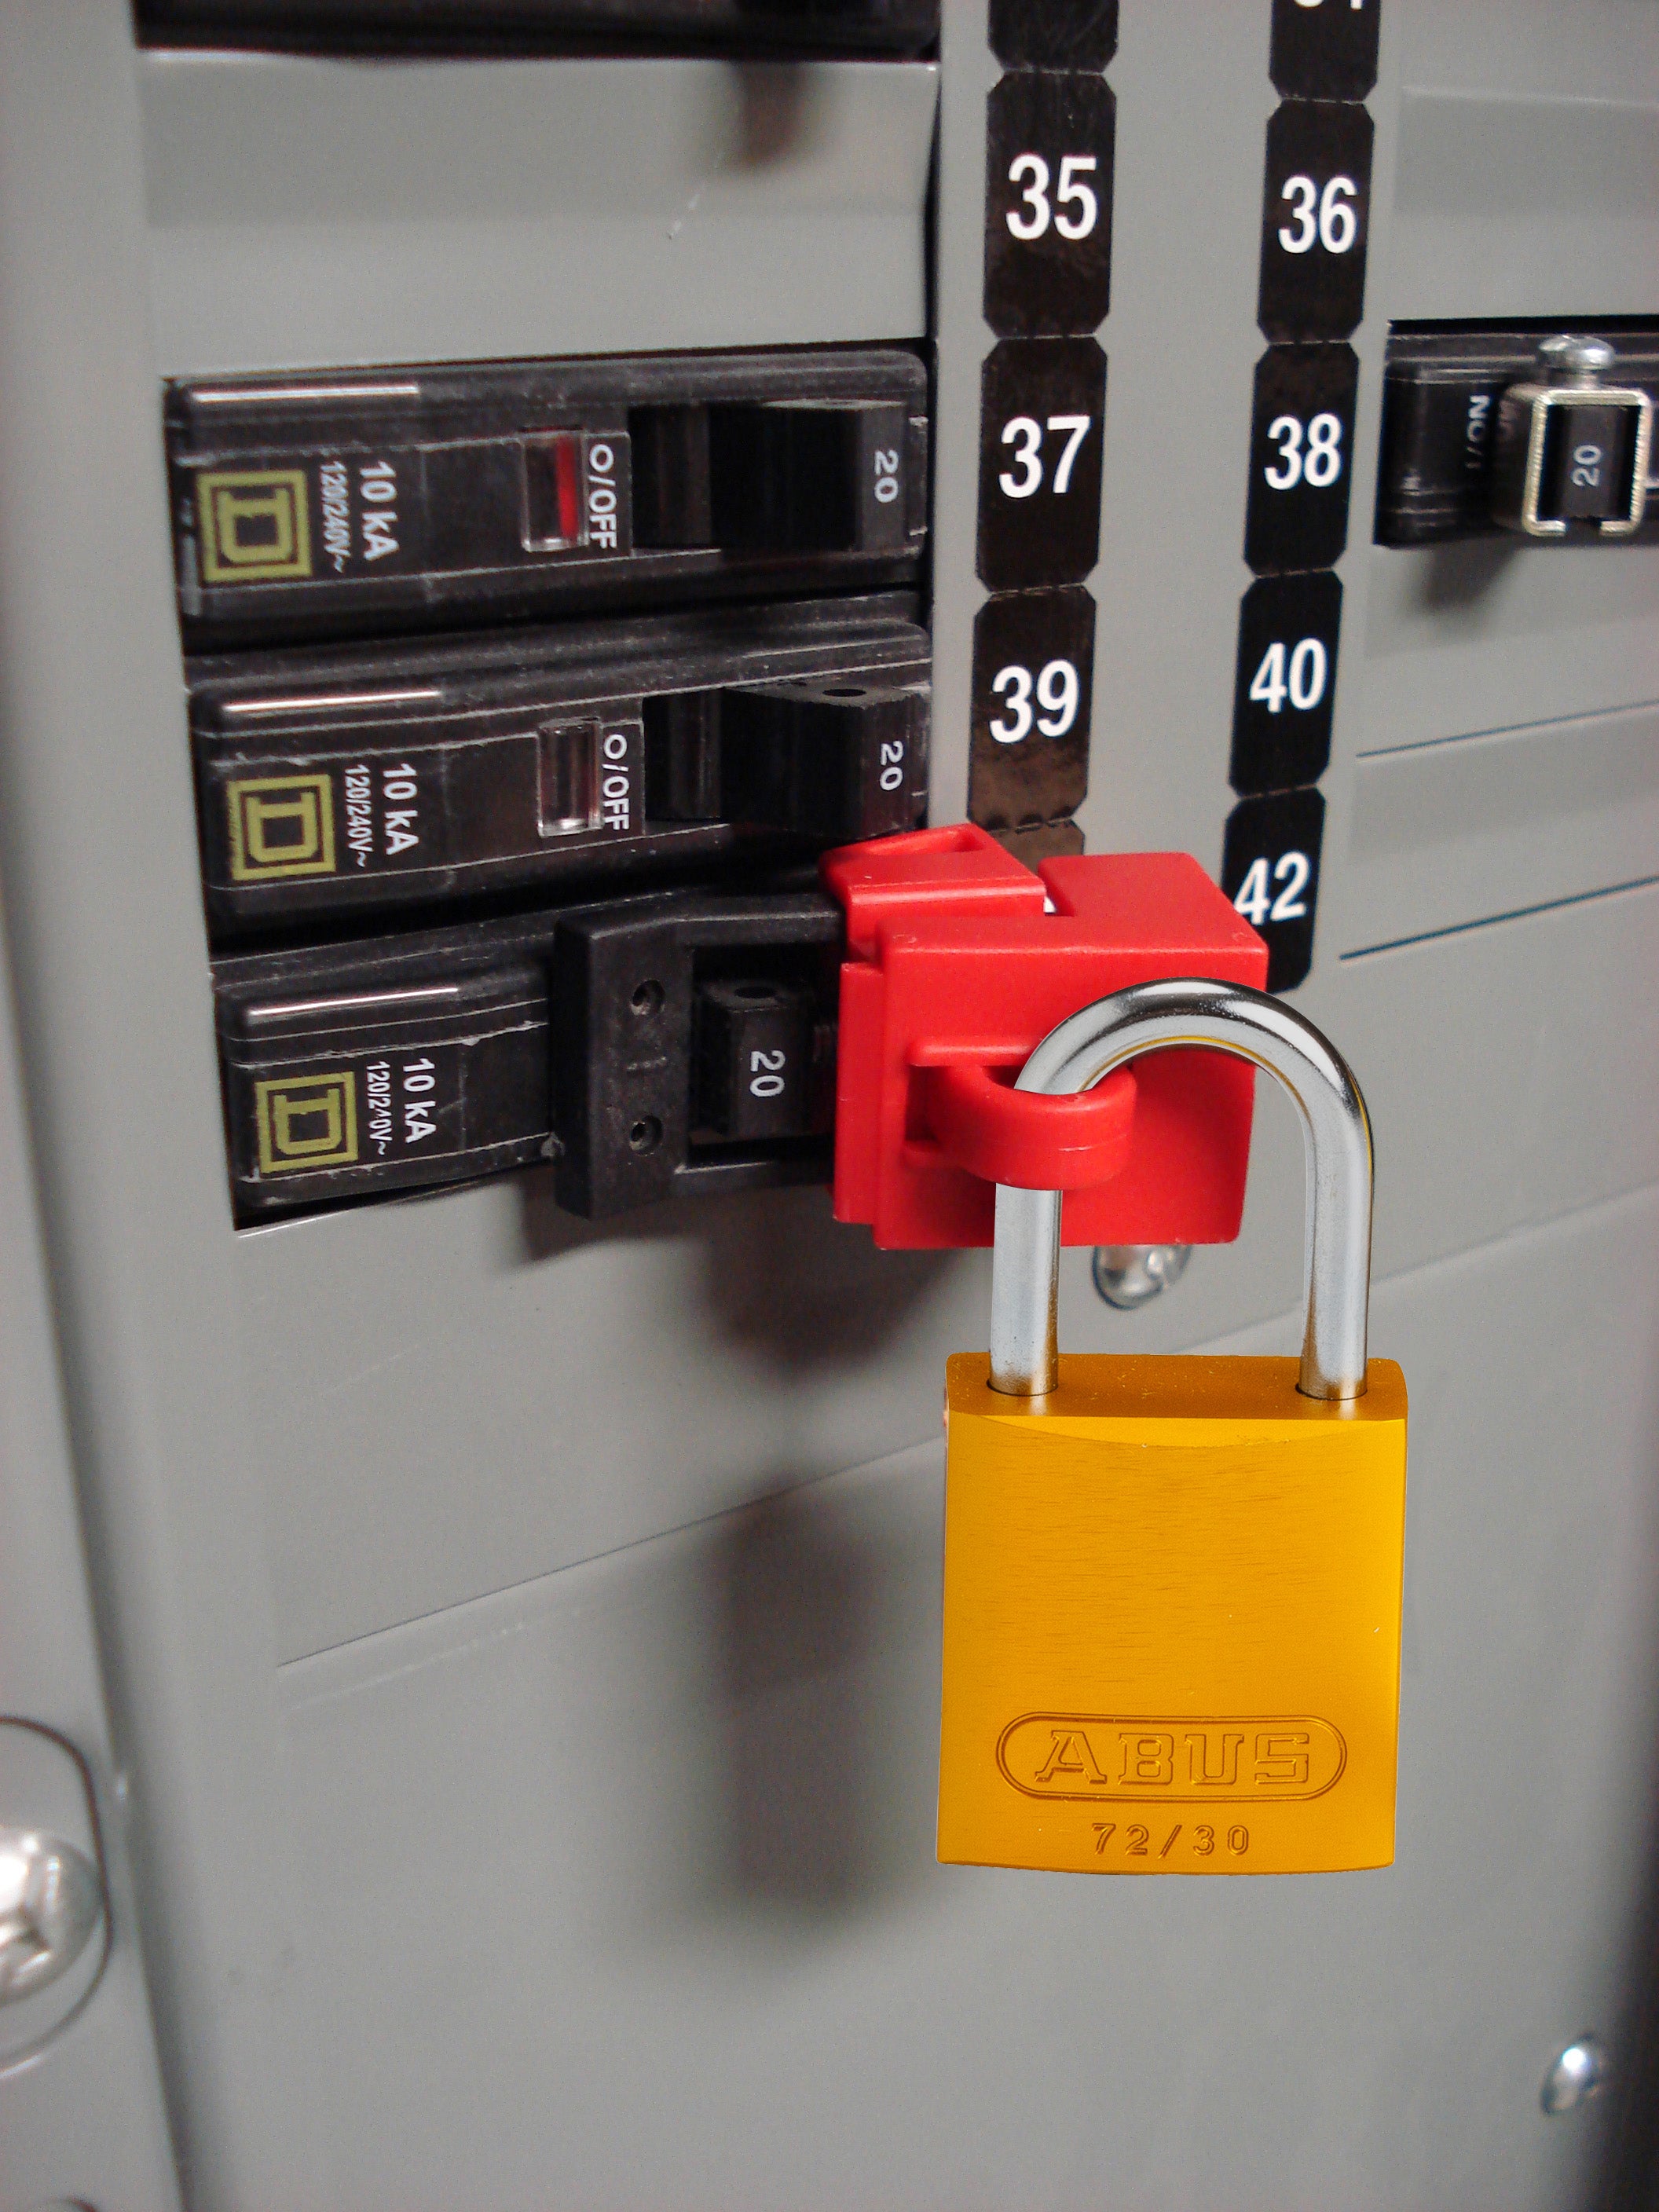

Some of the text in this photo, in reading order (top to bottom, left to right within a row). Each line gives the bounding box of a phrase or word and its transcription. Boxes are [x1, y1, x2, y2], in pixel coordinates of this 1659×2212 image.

[1006, 154, 1097, 240] 35
[1278, 175, 1357, 254] 36
[874, 449, 899, 504] 20
[998, 416, 1090, 498] 37
[1265, 413, 1342, 489] 38
[1572, 445, 1602, 487] 20
[359, 460, 400, 562] 10 kA
[989, 659, 1079, 744] 39
[1250, 638, 1327, 713] 40
[880, 740, 903, 791] 20
[383, 763, 419, 855] 10 kA
[1233, 851, 1310, 925] 42
[402, 1057, 438, 1144] 10 kA
[749, 1049, 786, 1098] 20
[1034, 1730, 1311, 1785] ABUS
[1091, 1822, 1251, 1859] 72/30
